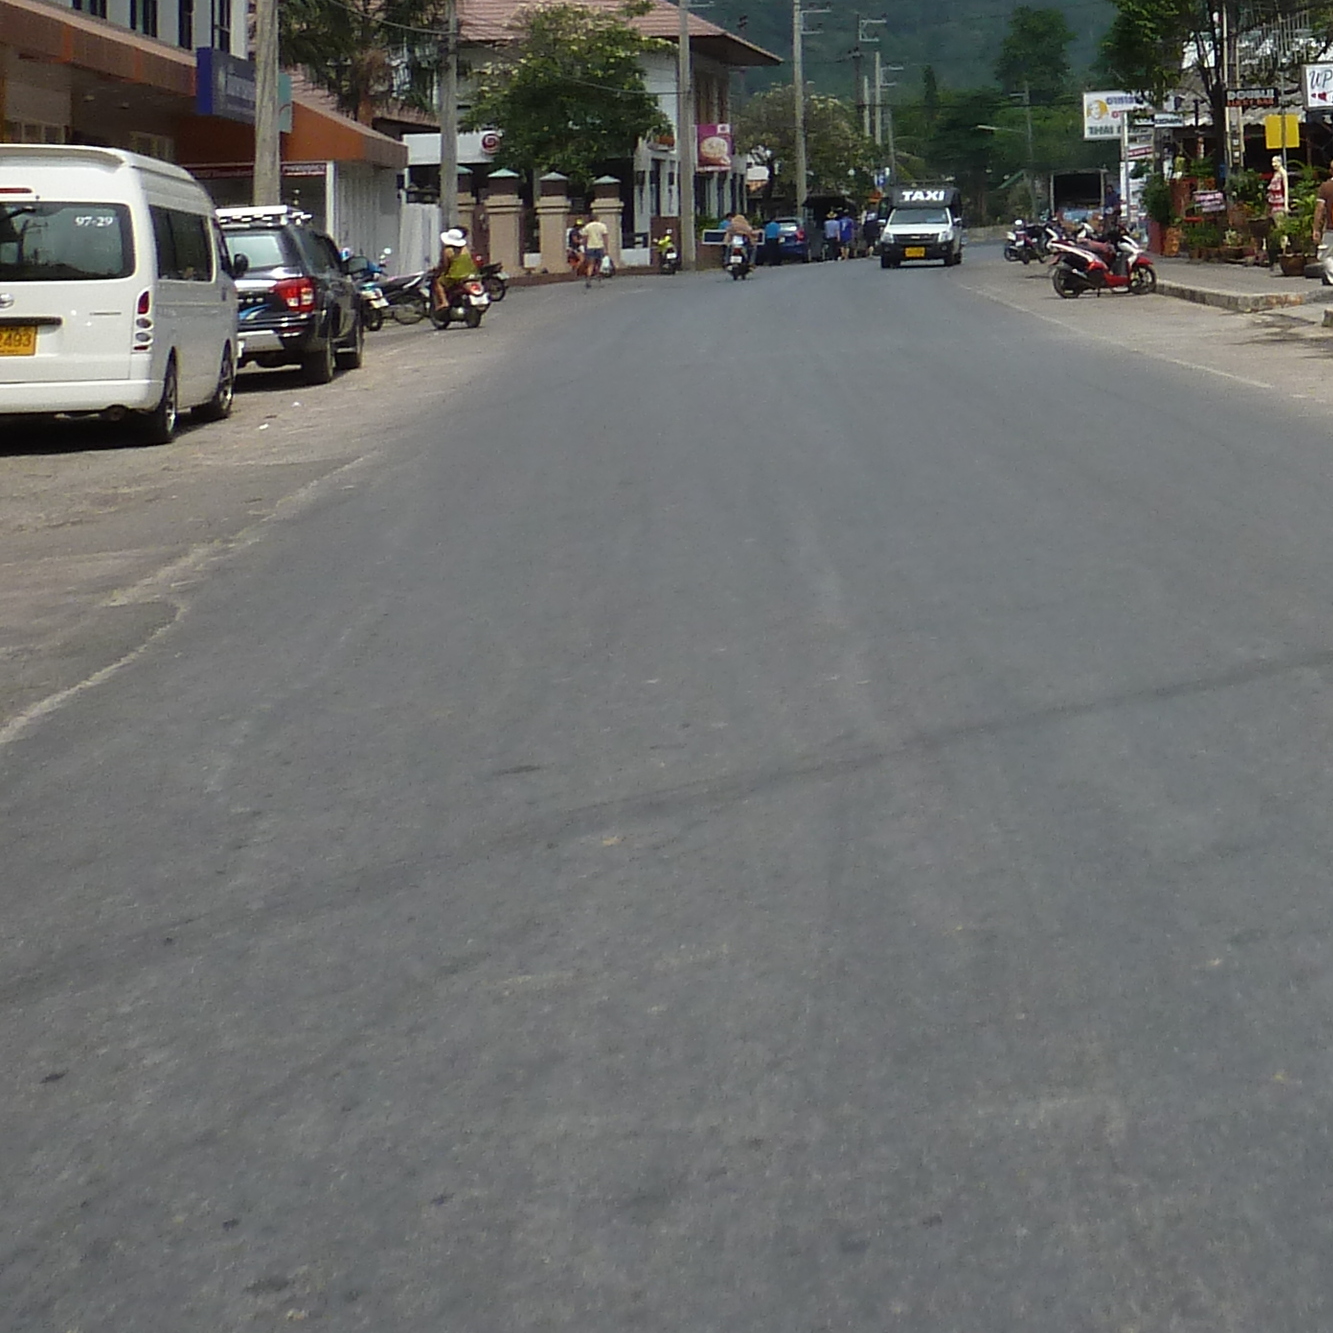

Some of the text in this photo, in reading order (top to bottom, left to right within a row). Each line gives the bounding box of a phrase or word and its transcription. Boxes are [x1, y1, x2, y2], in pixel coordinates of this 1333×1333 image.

[1310, 69, 1333, 90] UP
[901, 190, 945, 201] TAXI
[74, 216, 114, 227] 97-29
